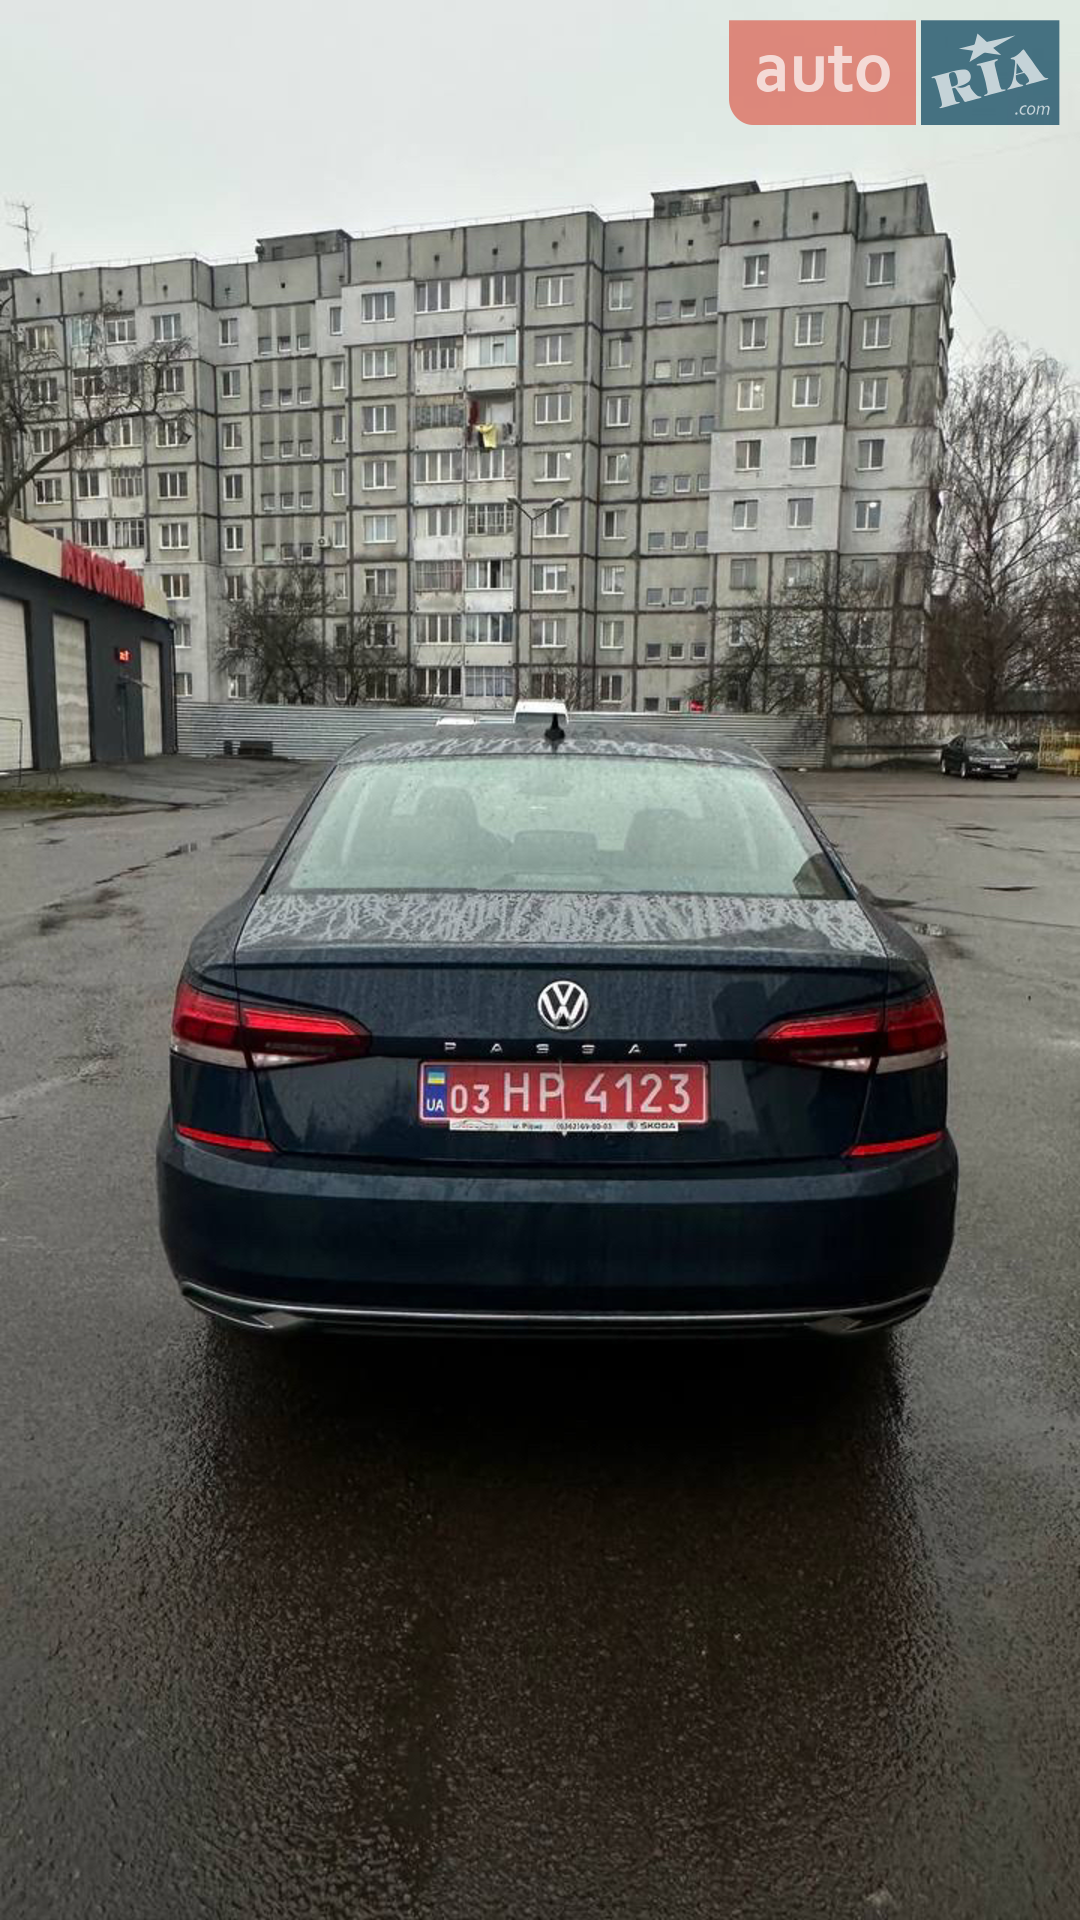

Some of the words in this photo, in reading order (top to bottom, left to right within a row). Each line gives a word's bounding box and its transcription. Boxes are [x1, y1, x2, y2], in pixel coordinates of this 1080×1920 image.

[444, 1041, 688, 1054] PASSAT
[450, 1084, 490, 1114] 03
[584, 1073, 691, 1114] 4123
[426, 1098, 445, 1111] UA
